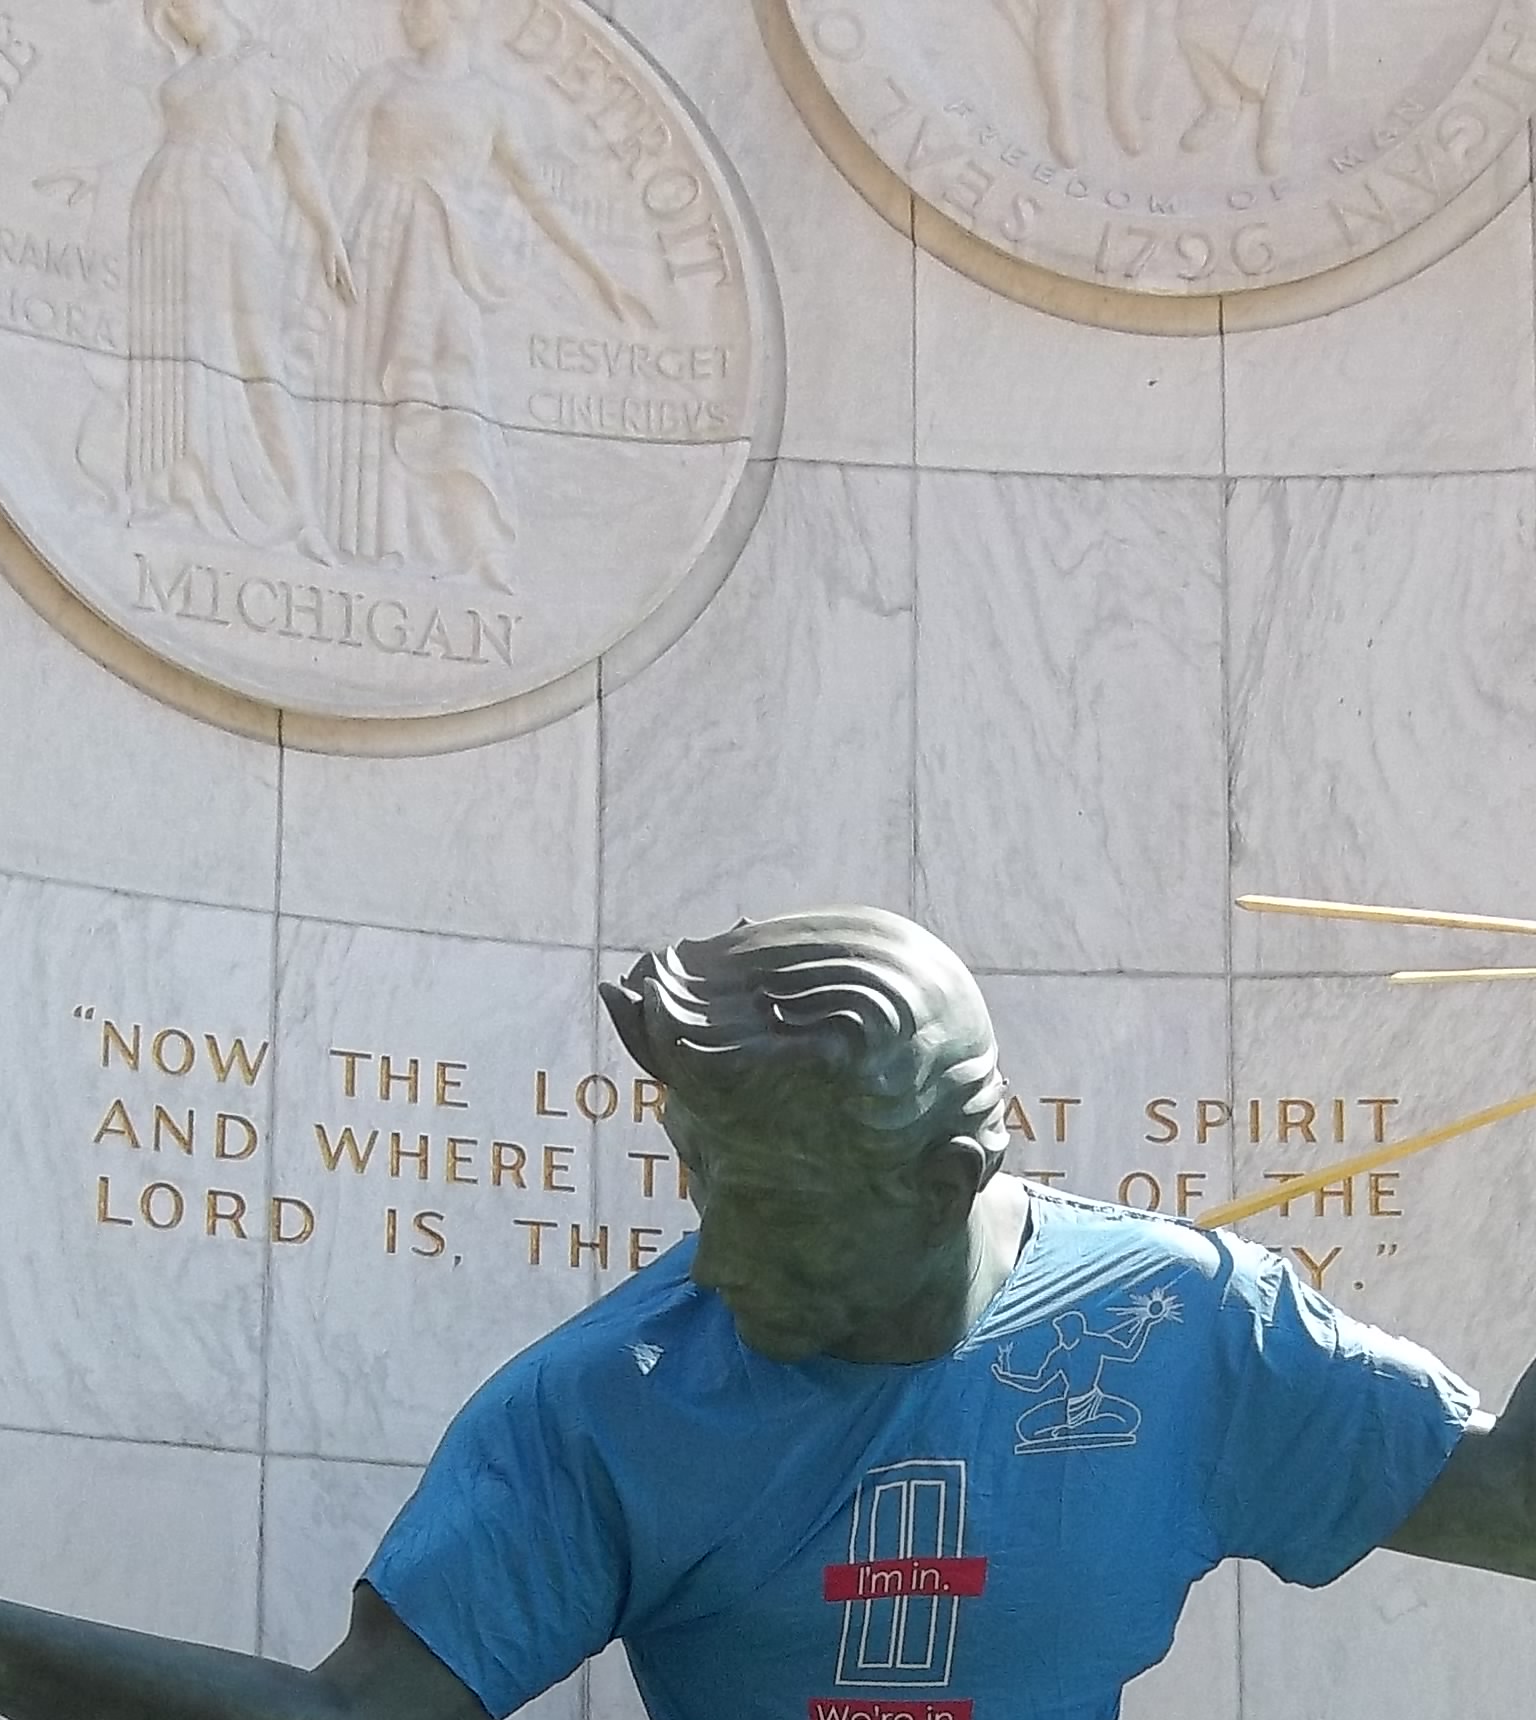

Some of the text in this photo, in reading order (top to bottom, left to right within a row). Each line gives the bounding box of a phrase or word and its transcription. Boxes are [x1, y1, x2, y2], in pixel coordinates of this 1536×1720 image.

[503, 1, 732, 288] DETROIT
[1094, 220, 1276, 281] 1796
[528, 331, 732, 381] RESVRGET
[133, 552, 523, 667] MICHIGAN
[330, 1047, 470, 1109] THE
[1145, 1097, 1400, 1145] SPIRIT
[93, 1098, 259, 1162] AND
[315, 1122, 576, 1194] WHERE
[1118, 1171, 1208, 1217] OF
[1264, 1171, 1403, 1218] THE
[97, 1175, 316, 1245] LORD
[385, 1207, 463, 1268] IS,
[857, 1560, 951, 1596] I'm in.
